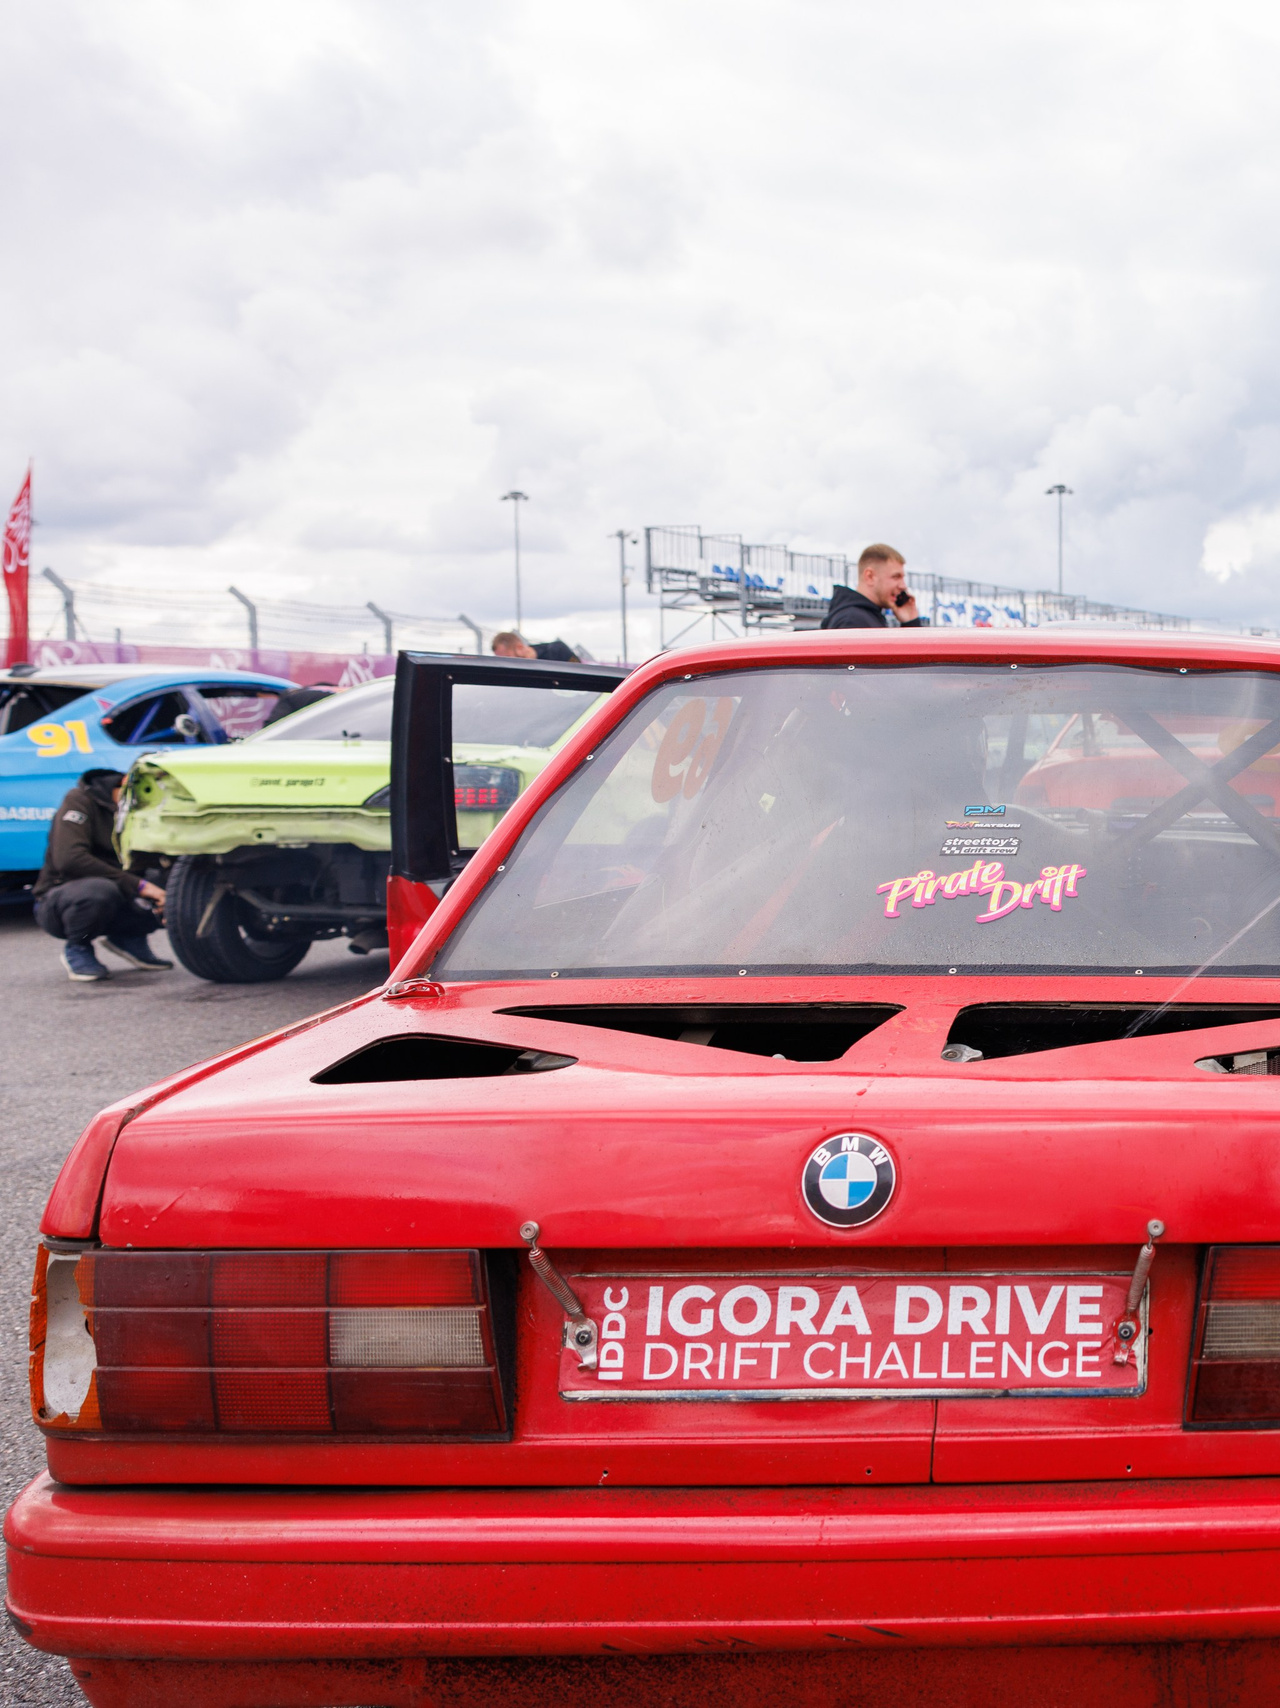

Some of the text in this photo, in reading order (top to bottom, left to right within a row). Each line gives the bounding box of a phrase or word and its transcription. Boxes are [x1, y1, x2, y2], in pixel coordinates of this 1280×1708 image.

[27, 720, 94, 757] 91
[945, 837, 1019, 847] streettoy's
[877, 859, 1087, 924] Pirate Drift
[812, 1135, 889, 1167] BMW
[646, 1285, 1103, 1336] IGORA DRIVE
[598, 1286, 629, 1380] IDDC
[643, 1341, 1102, 1380] DRIFT CHALLENGE
